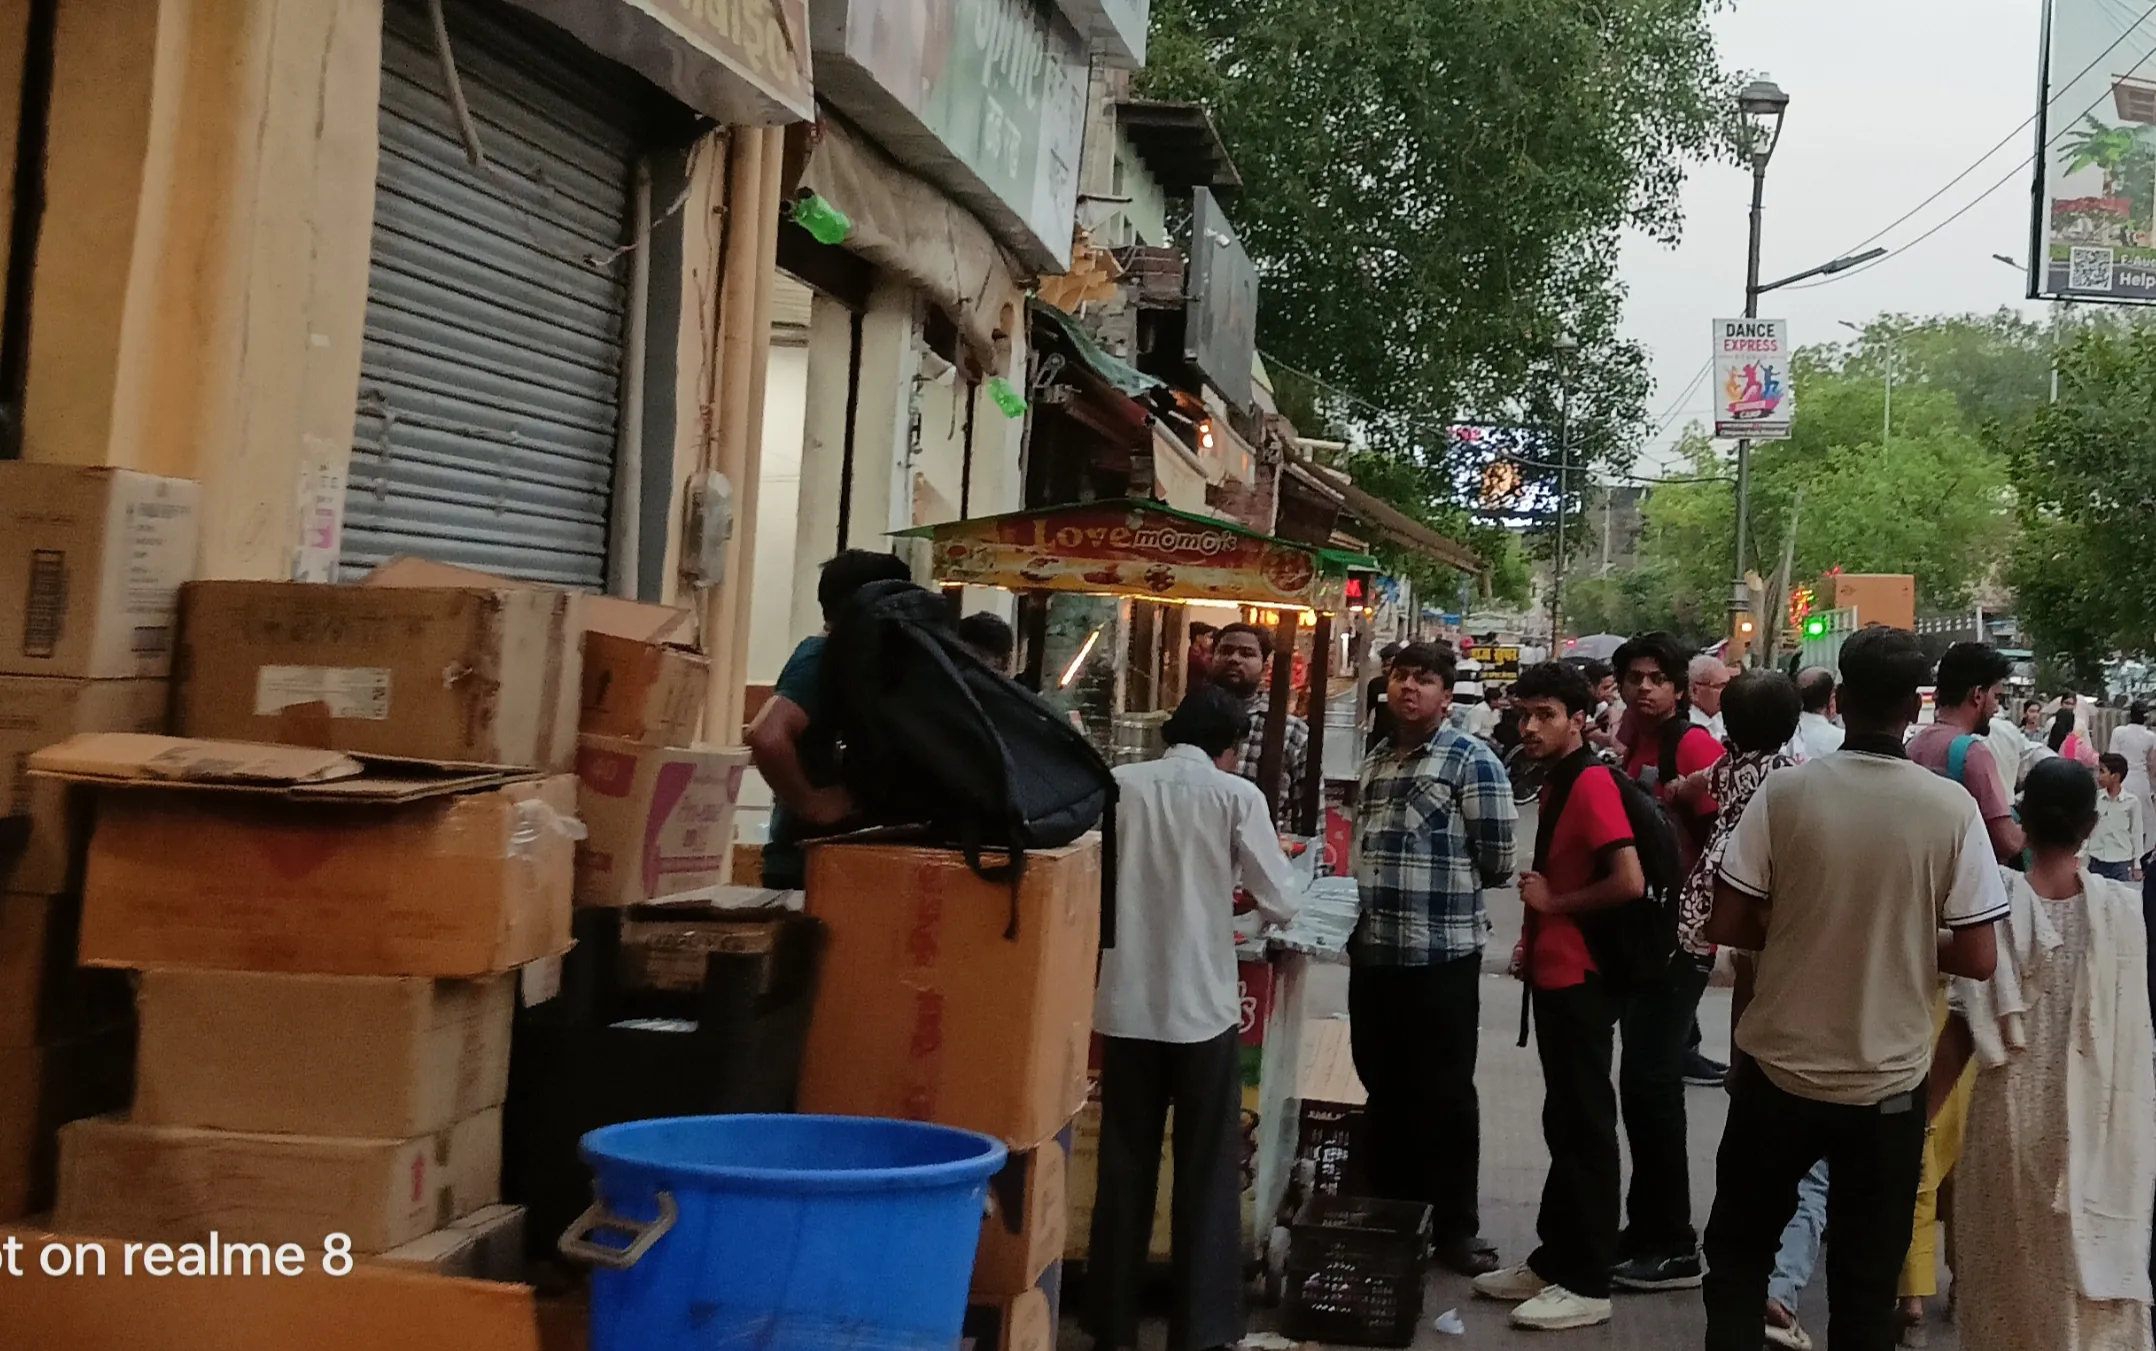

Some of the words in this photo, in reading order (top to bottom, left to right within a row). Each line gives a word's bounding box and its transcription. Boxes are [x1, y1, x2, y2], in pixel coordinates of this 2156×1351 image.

[1726, 323, 1776, 338] DANCE
[1723, 338, 1778, 352] EXPRESS
[1033, 519, 1133, 549] Love
